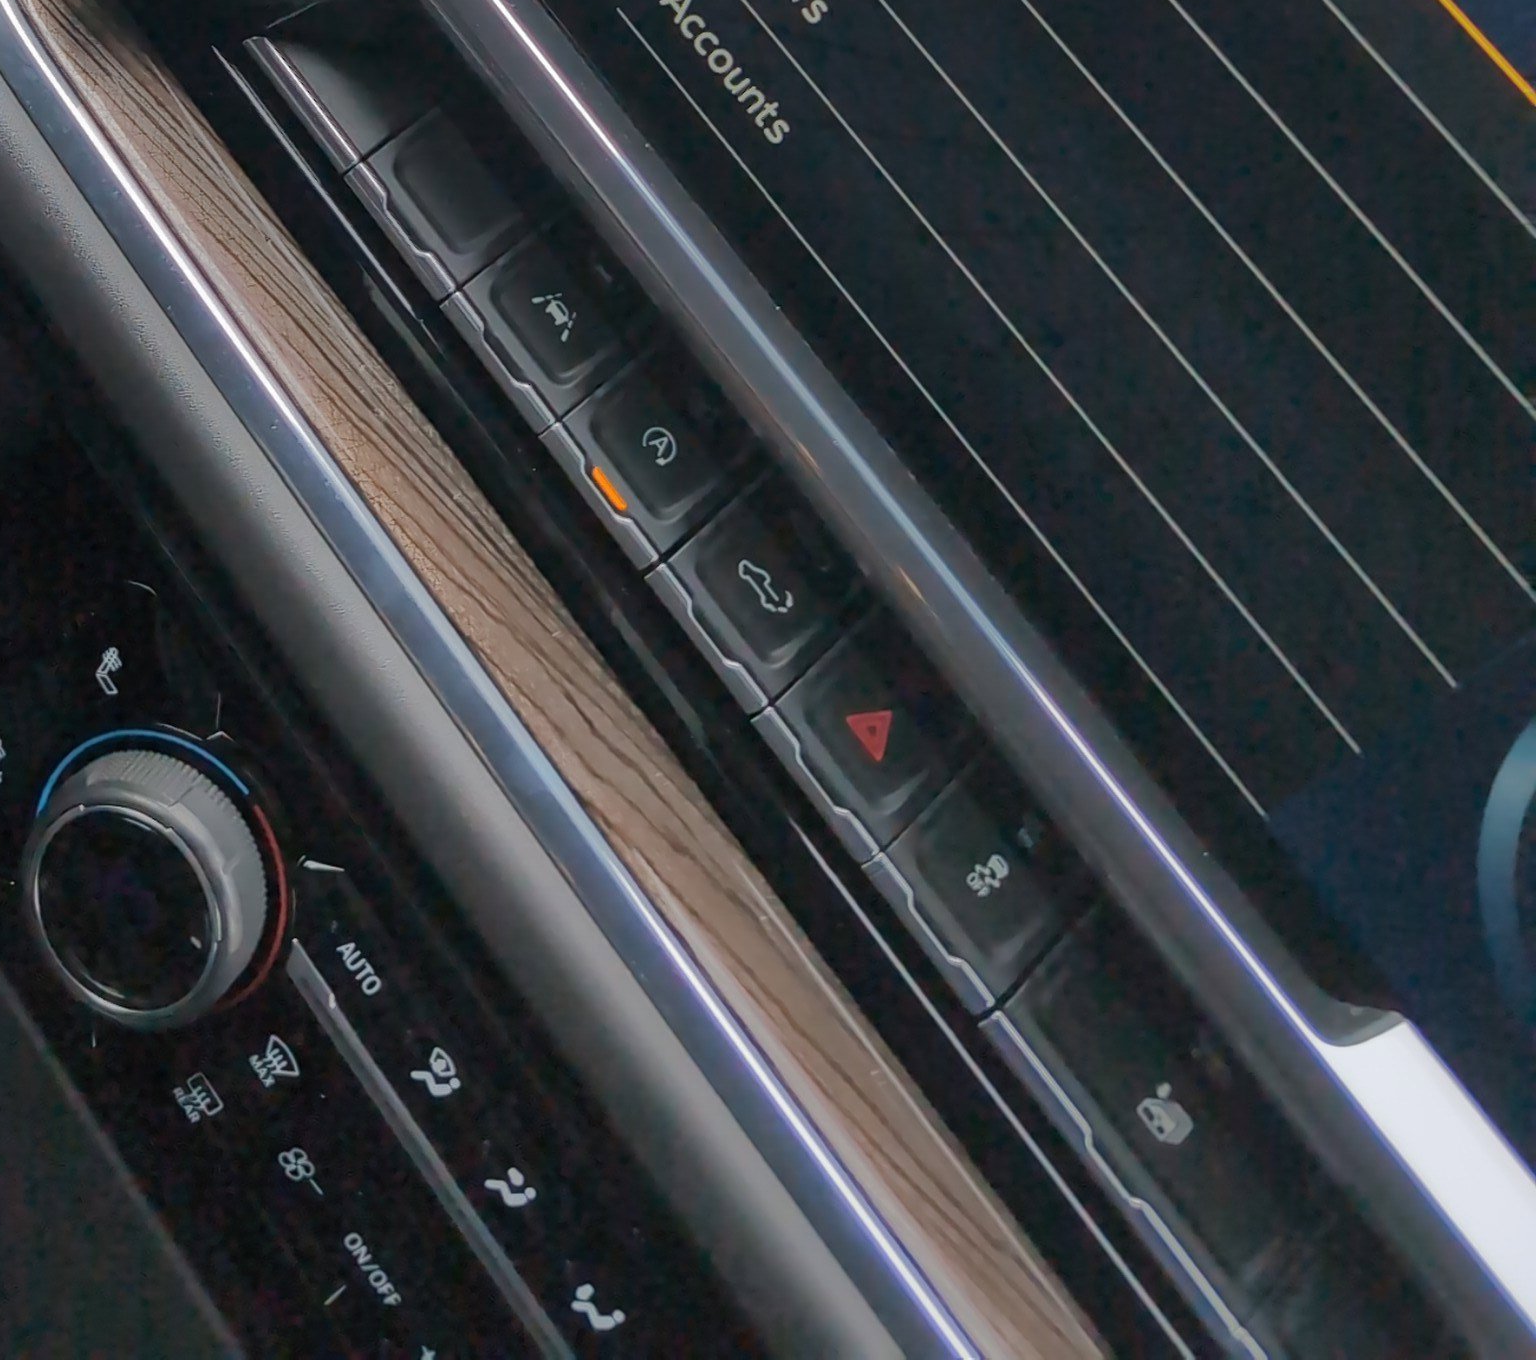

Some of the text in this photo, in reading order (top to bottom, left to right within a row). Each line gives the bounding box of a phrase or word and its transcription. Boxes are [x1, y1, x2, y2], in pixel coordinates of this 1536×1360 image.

[337, 941, 382, 995] AUTO
[249, 1054, 275, 1088] MAX
[172, 1086, 202, 1124] REAR
[344, 1232, 401, 1307] ON/OFF
